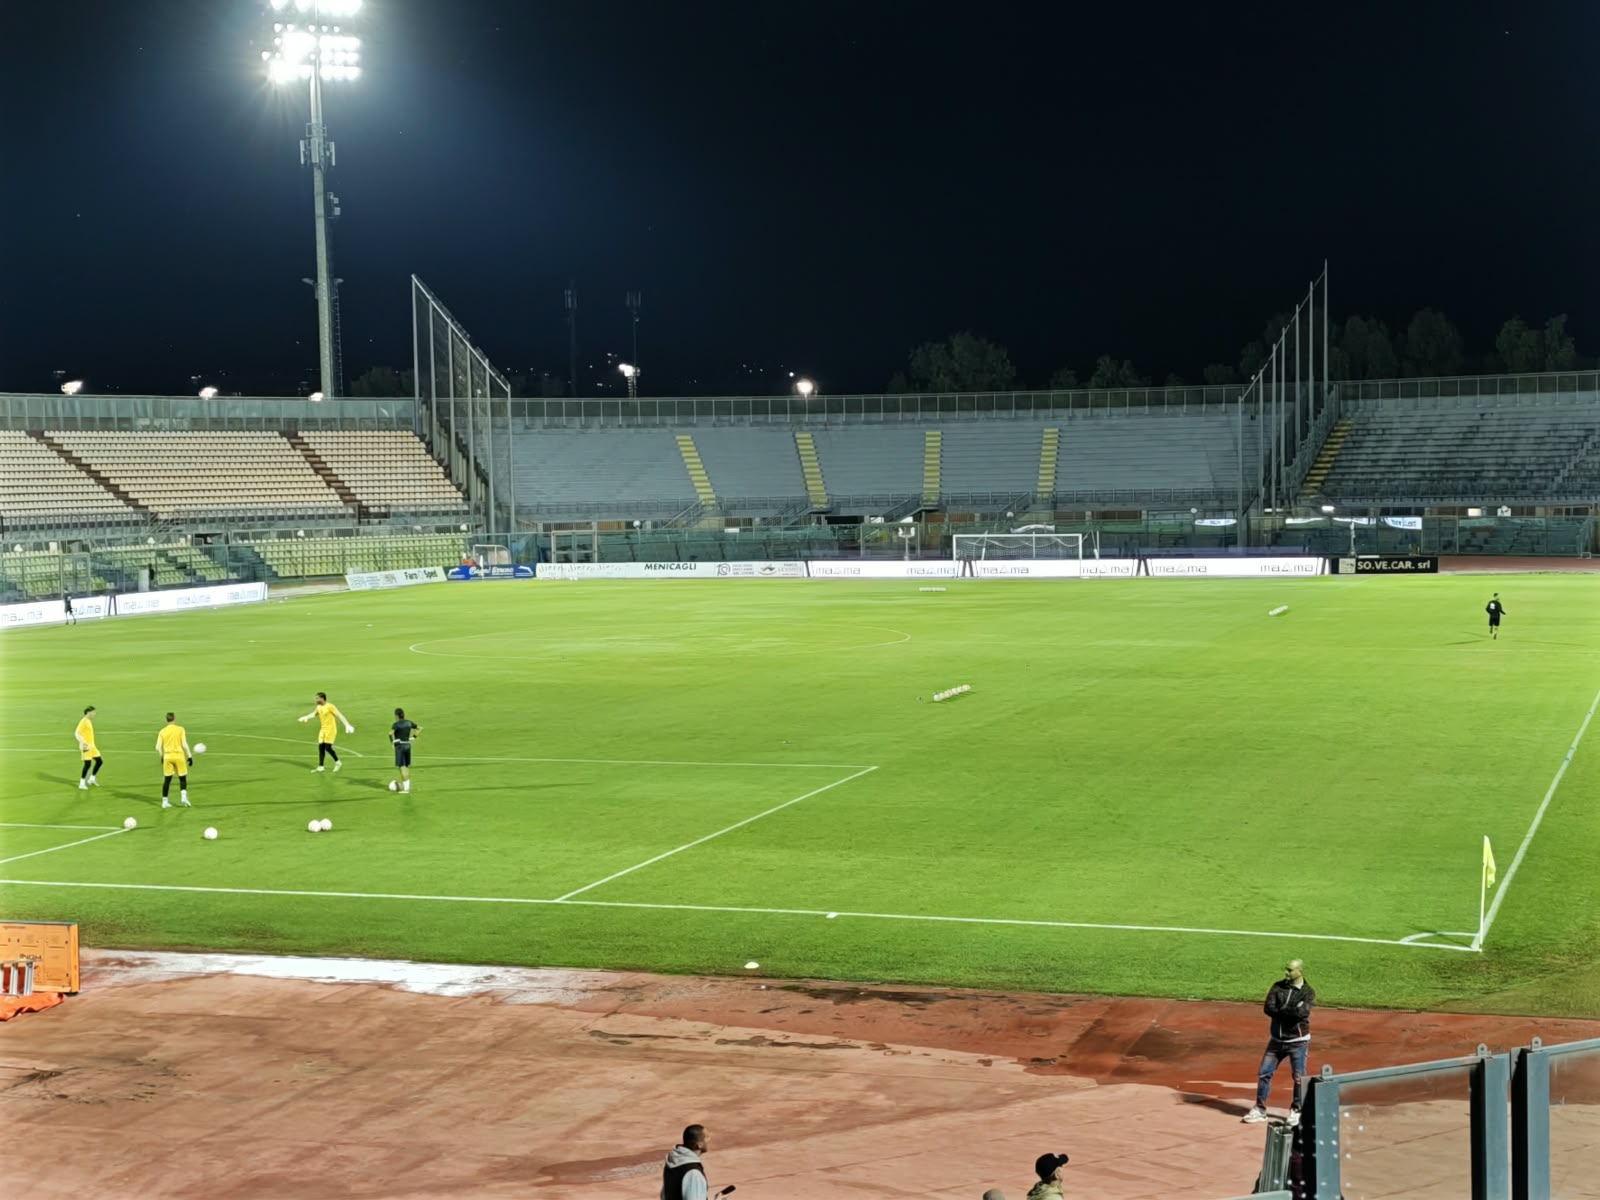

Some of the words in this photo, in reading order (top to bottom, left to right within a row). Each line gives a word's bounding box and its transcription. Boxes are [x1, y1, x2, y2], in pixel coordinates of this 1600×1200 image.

[644, 563, 697, 571] MENICAGLI
[1357, 561, 1415, 570] SO.VE.CAR.
[1417, 560, 1431, 569] srl
